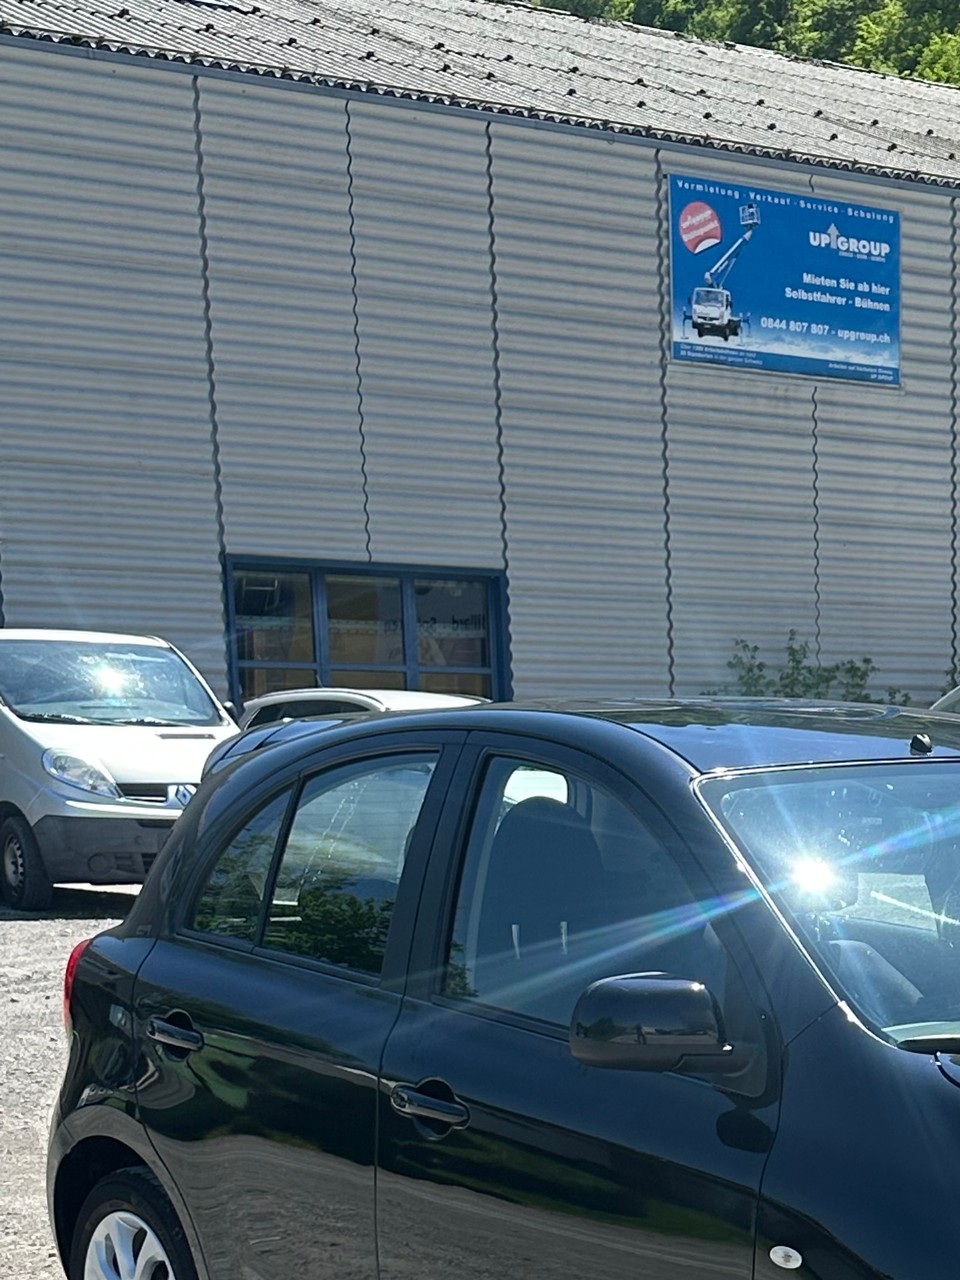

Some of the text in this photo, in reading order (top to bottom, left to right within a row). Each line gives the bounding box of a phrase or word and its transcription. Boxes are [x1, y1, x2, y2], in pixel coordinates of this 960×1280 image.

[677, 180, 894, 224] Vermietung Verkauf Service Schulung
[837, 236, 891, 257] GROUP
[803, 272, 890, 295] Mieten Sie ab hier
[785, 287, 890, 312] Selbstfahrer Bühnen
[761, 317, 891, 344] 0844 807 807 upgroup.ch
